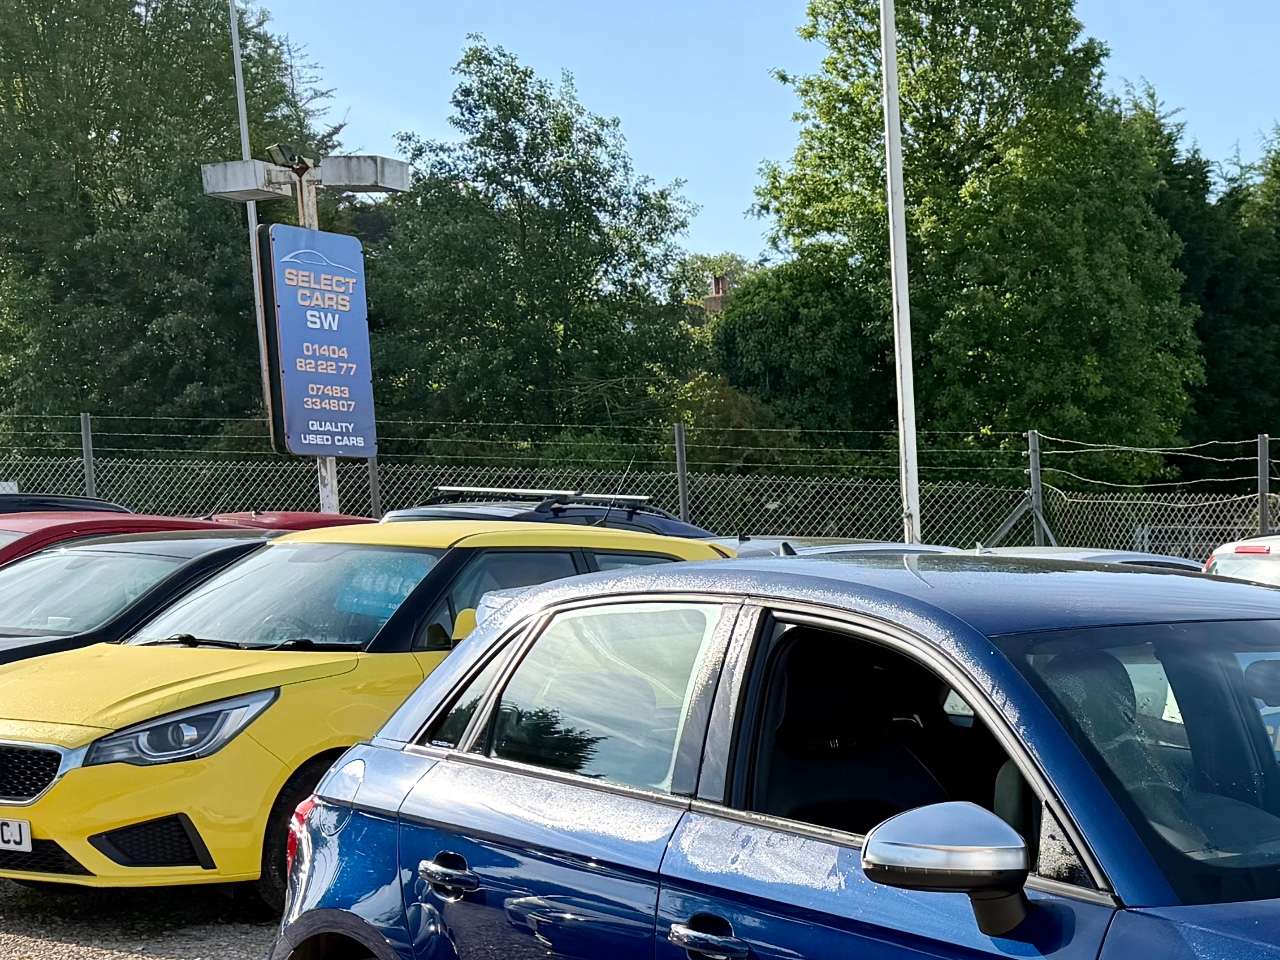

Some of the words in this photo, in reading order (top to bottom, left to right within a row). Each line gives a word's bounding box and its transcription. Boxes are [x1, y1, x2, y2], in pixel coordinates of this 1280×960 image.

[284, 268, 356, 293] SELECT
[297, 289, 350, 312] CARS
[306, 309, 339, 331] SW
[303, 342, 348, 359] 01404
[296, 358, 315, 372] 82
[317, 359, 337, 374] 22
[338, 362, 356, 376] 77
[308, 383, 349, 398] 07483
[303, 397, 355, 411] 334807
[308, 420, 354, 433] QUALITY
[301, 433, 332, 445] USED
[334, 435, 364, 447] CARS
